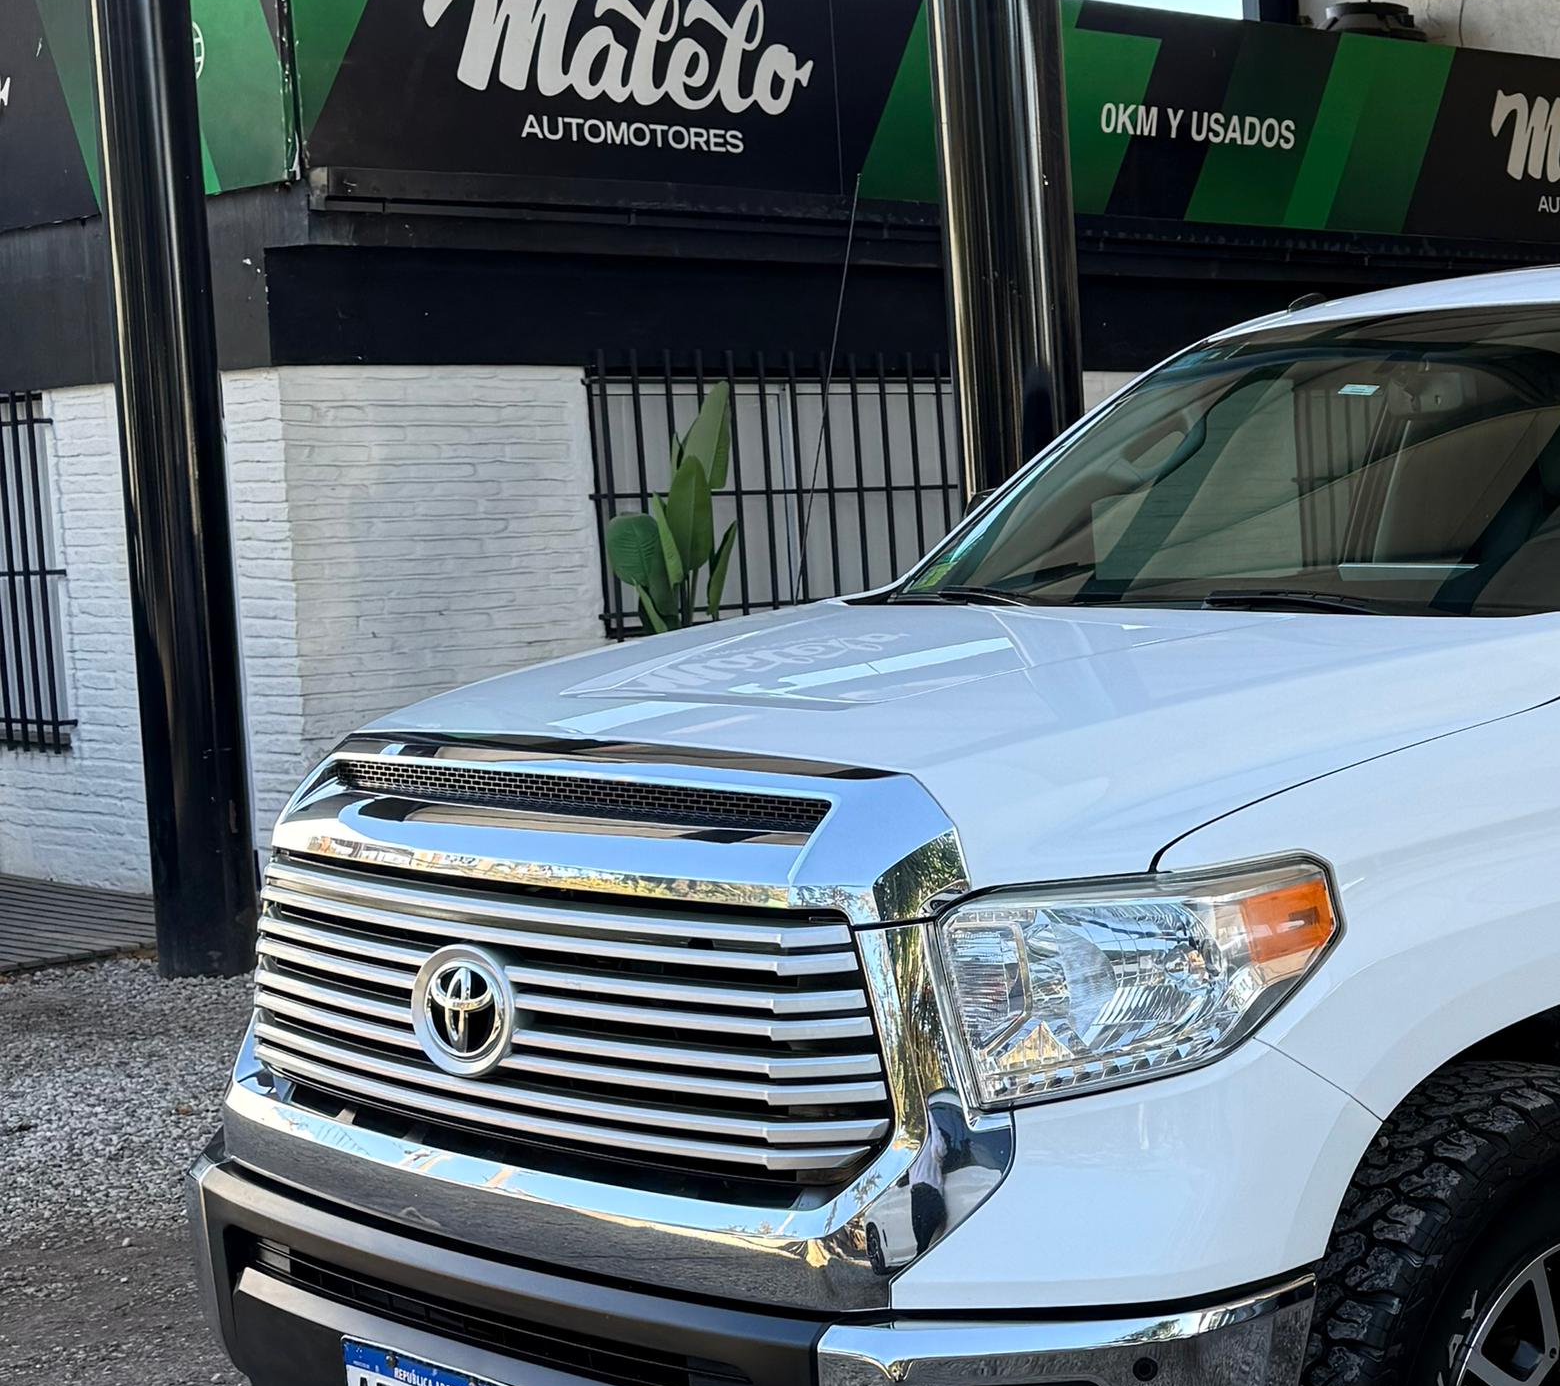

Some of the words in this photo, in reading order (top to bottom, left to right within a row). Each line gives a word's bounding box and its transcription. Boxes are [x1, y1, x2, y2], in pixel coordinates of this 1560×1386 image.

[521, 113, 744, 154] AUTOMOTORES
[1167, 107, 1184, 139] Y
[1191, 111, 1296, 150] USADOS
